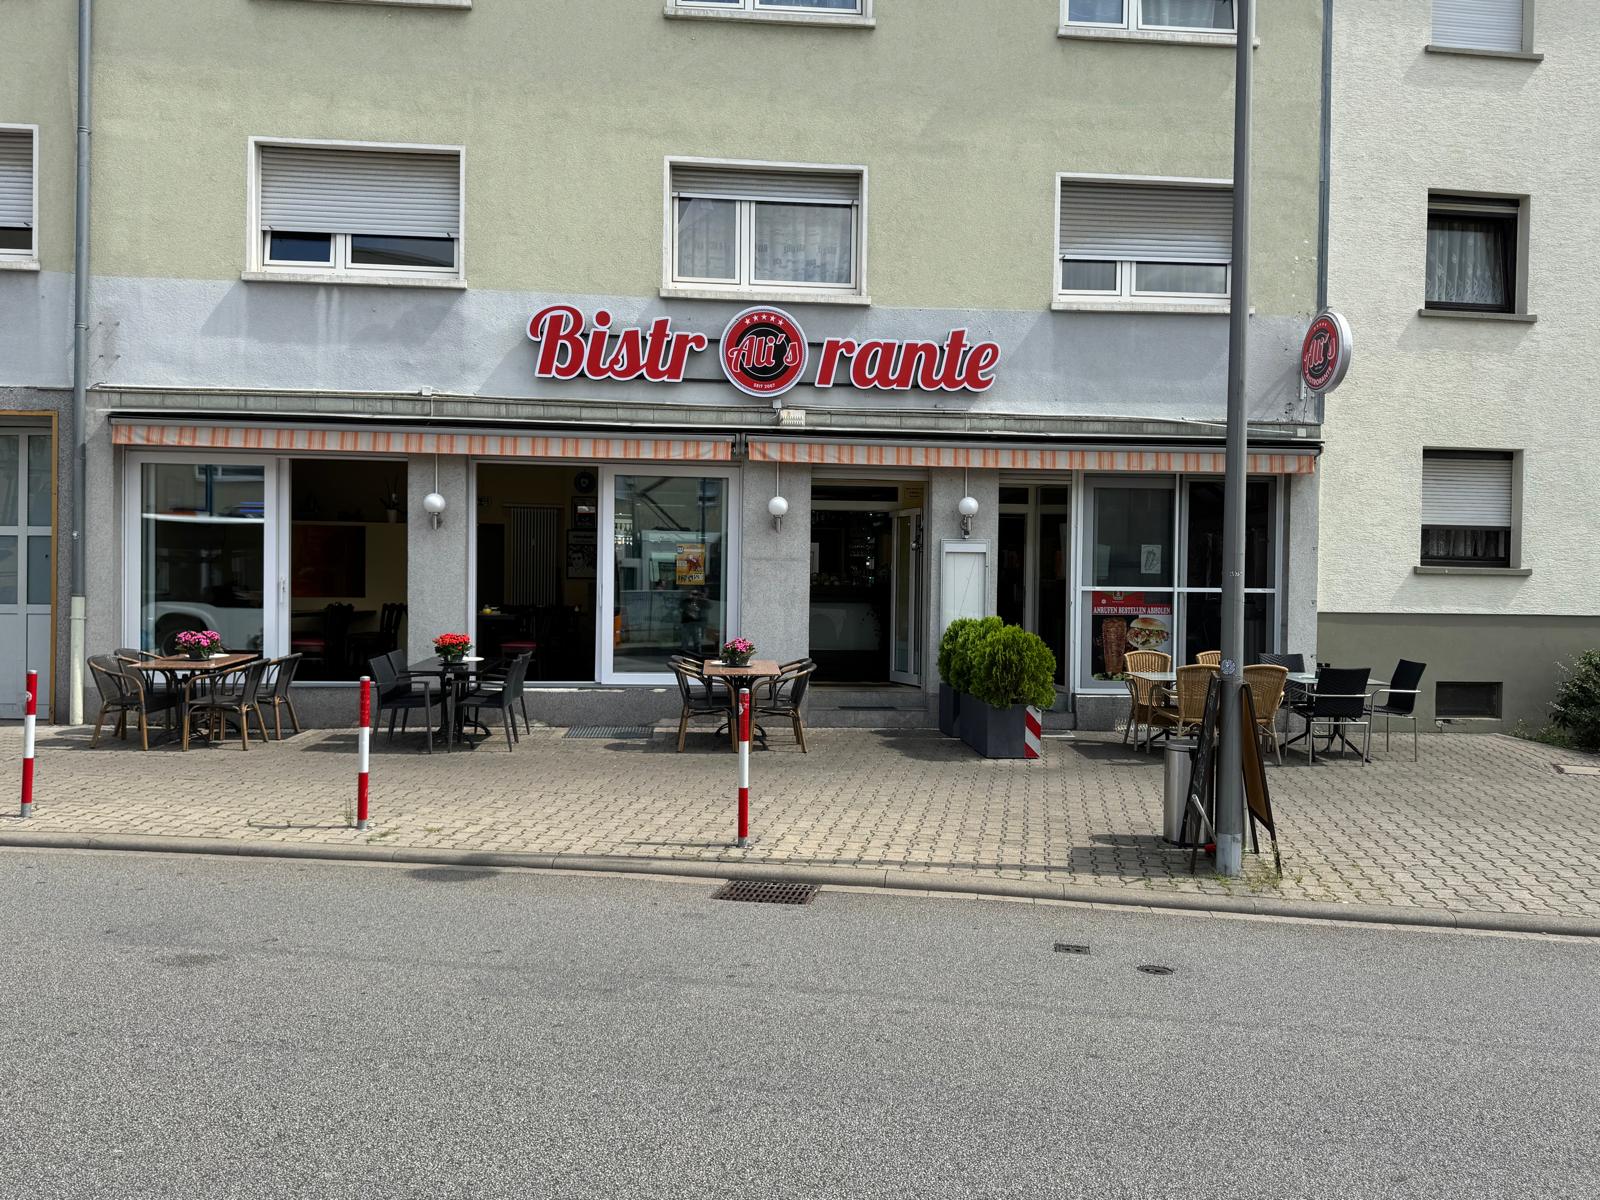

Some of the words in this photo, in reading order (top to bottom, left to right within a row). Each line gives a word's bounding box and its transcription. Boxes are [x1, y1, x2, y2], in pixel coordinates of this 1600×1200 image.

[528, 304, 707, 381] Bistr
[816, 328, 1000, 391] rante
[728, 334, 800, 372] Ali's
[1304, 333, 1336, 373] Ali's
[1093, 606, 1117, 614] ANRUFEN
